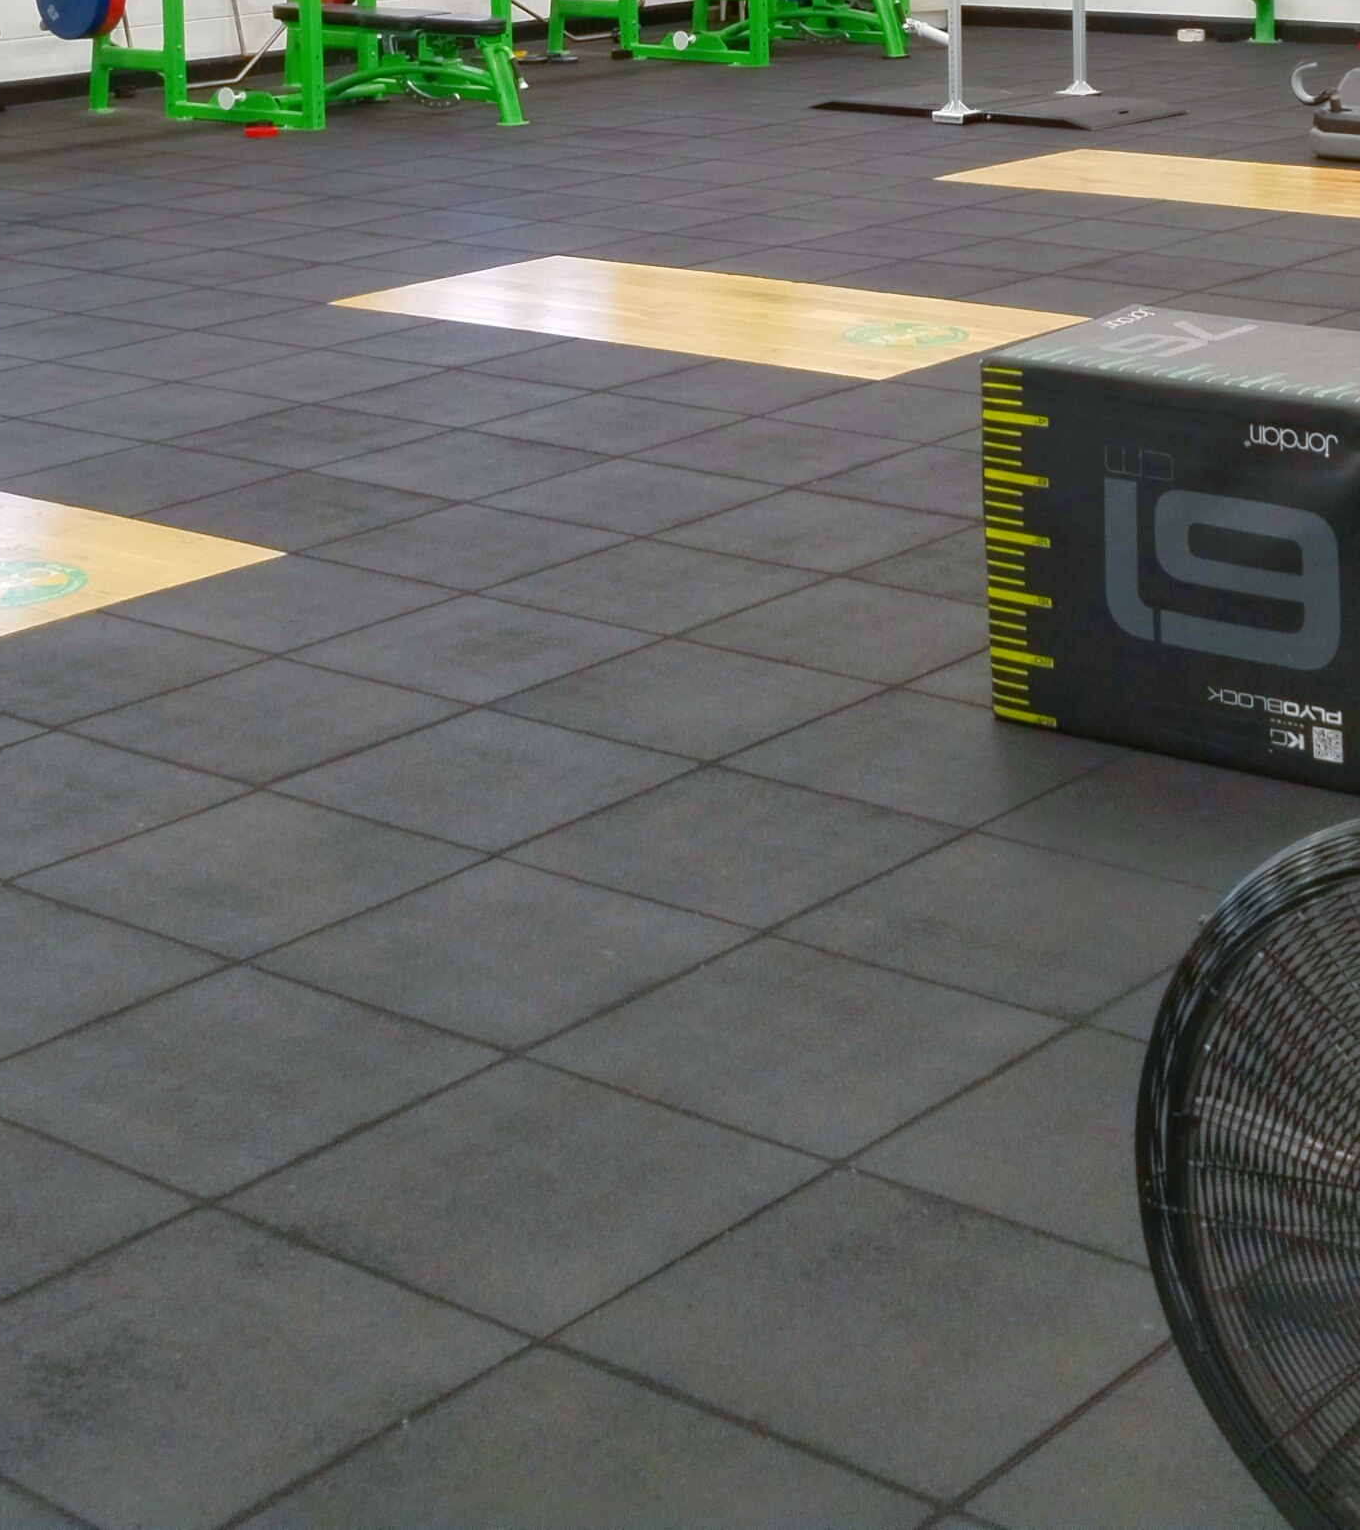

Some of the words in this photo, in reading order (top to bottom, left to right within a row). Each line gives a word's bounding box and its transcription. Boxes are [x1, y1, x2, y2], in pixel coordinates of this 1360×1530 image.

[1244, 423, 1339, 458] Jordan
[1104, 476, 1339, 671] 61
[1207, 686, 1342, 726] PLYOBLOCK
[1269, 728, 1305, 752] KG
